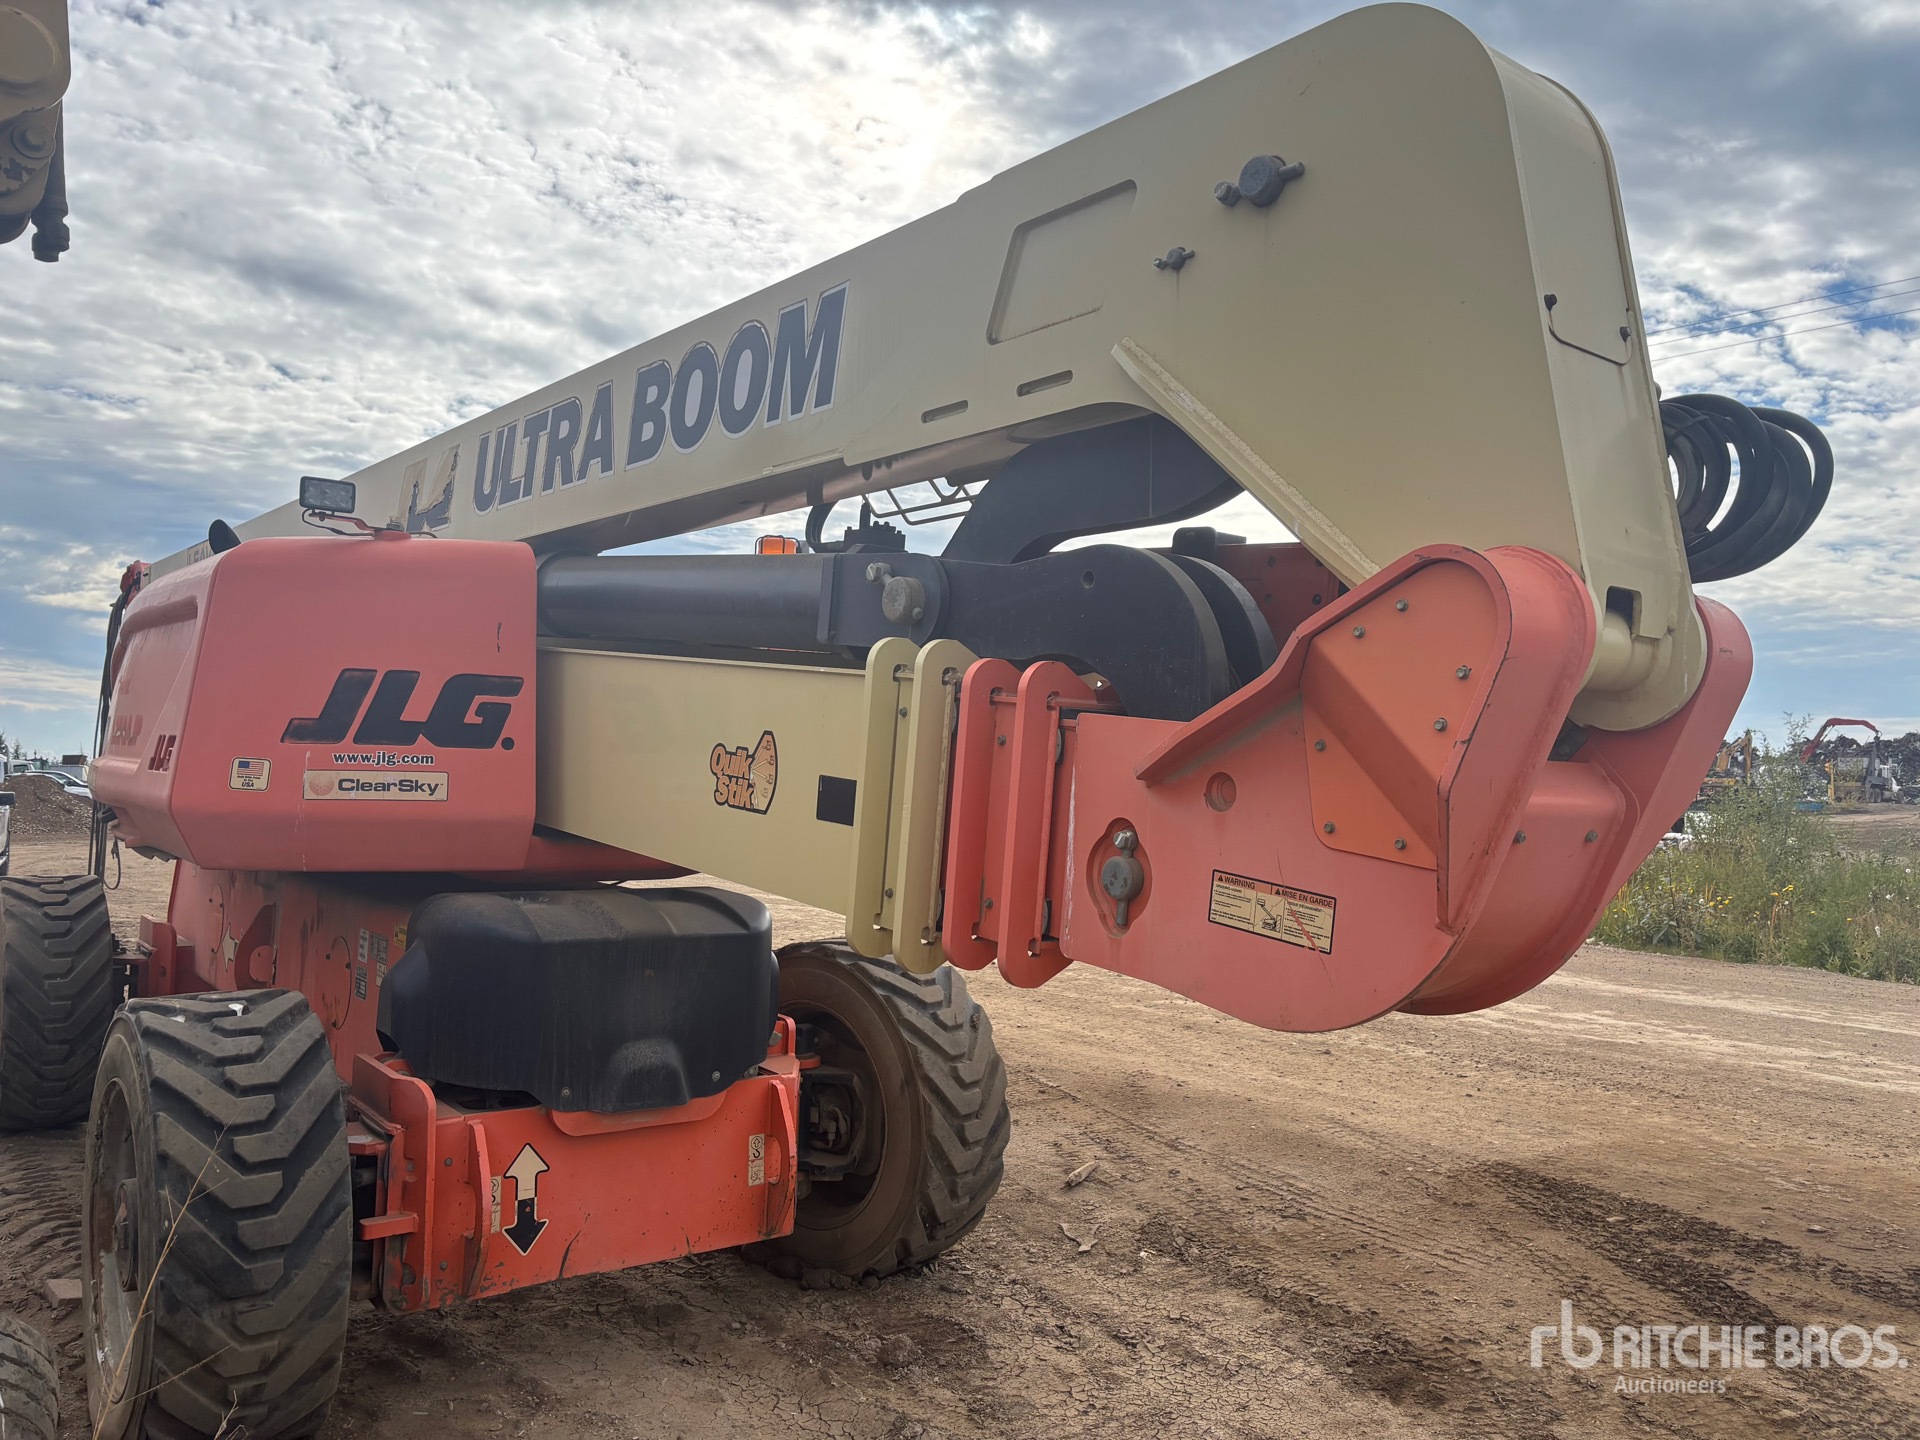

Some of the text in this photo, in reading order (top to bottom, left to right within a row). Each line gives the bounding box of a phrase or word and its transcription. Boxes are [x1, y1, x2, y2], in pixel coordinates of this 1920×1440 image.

[473, 380, 615, 517] ULTRA
[624, 280, 851, 472] BOOM
[147, 733, 177, 772] JLG
[333, 751, 436, 767] www.jlg.com
[711, 744, 754, 780] Quik
[337, 778, 440, 797] ClearSky
[714, 774, 753, 809] Stik
[1224, 875, 1256, 890] WARNING
[1281, 889, 1298, 900] MISE
[1298, 893, 1309, 902] EN
[1309, 896, 1333, 908] GARDE
